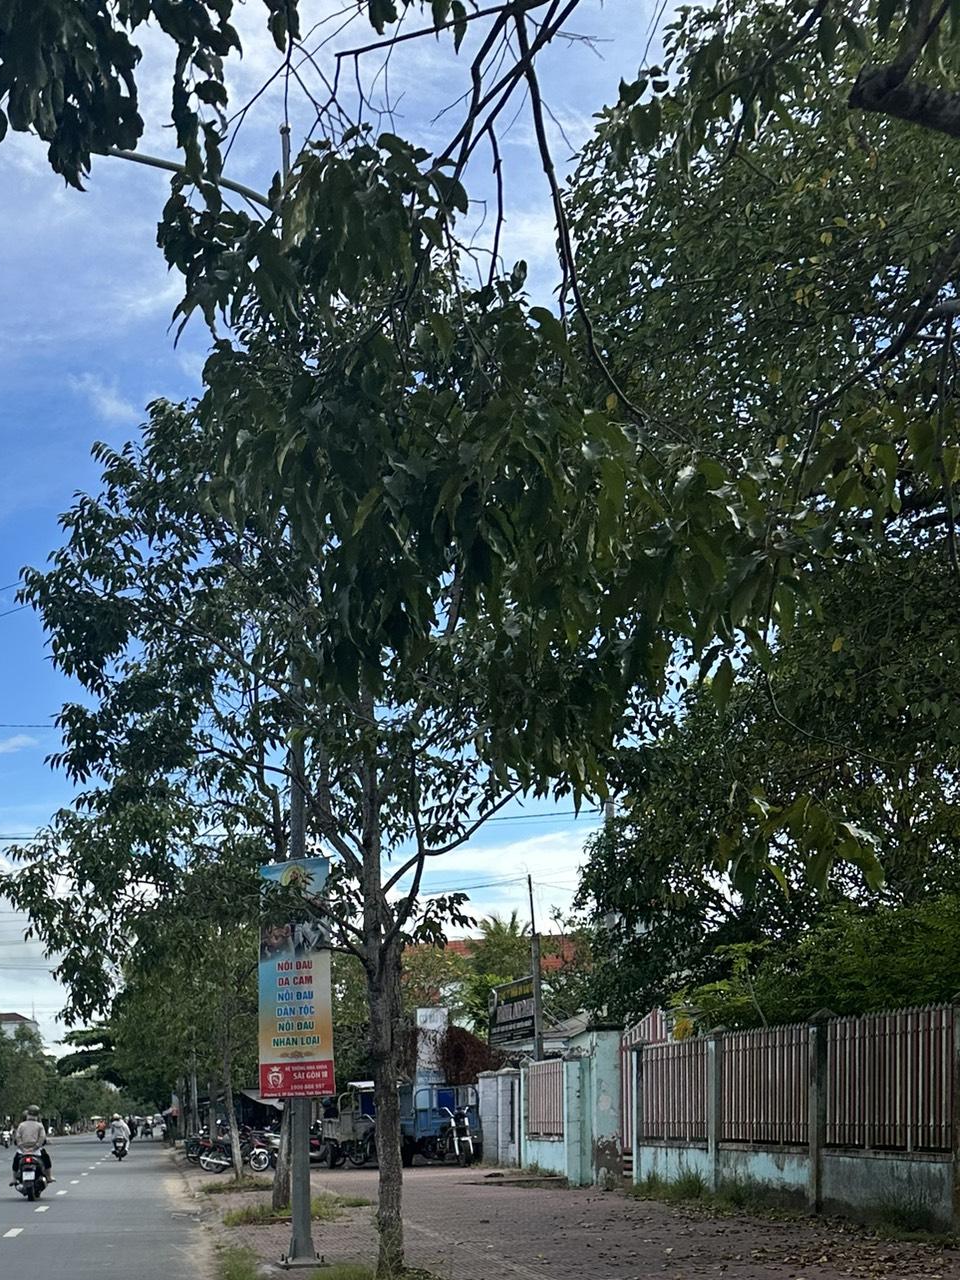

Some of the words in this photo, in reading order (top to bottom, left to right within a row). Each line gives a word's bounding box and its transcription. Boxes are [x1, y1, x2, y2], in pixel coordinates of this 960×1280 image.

[293, 975, 313, 985] CAM
[296, 990, 314, 1001] ĐAU
[296, 1021, 314, 1031] ĐAU
